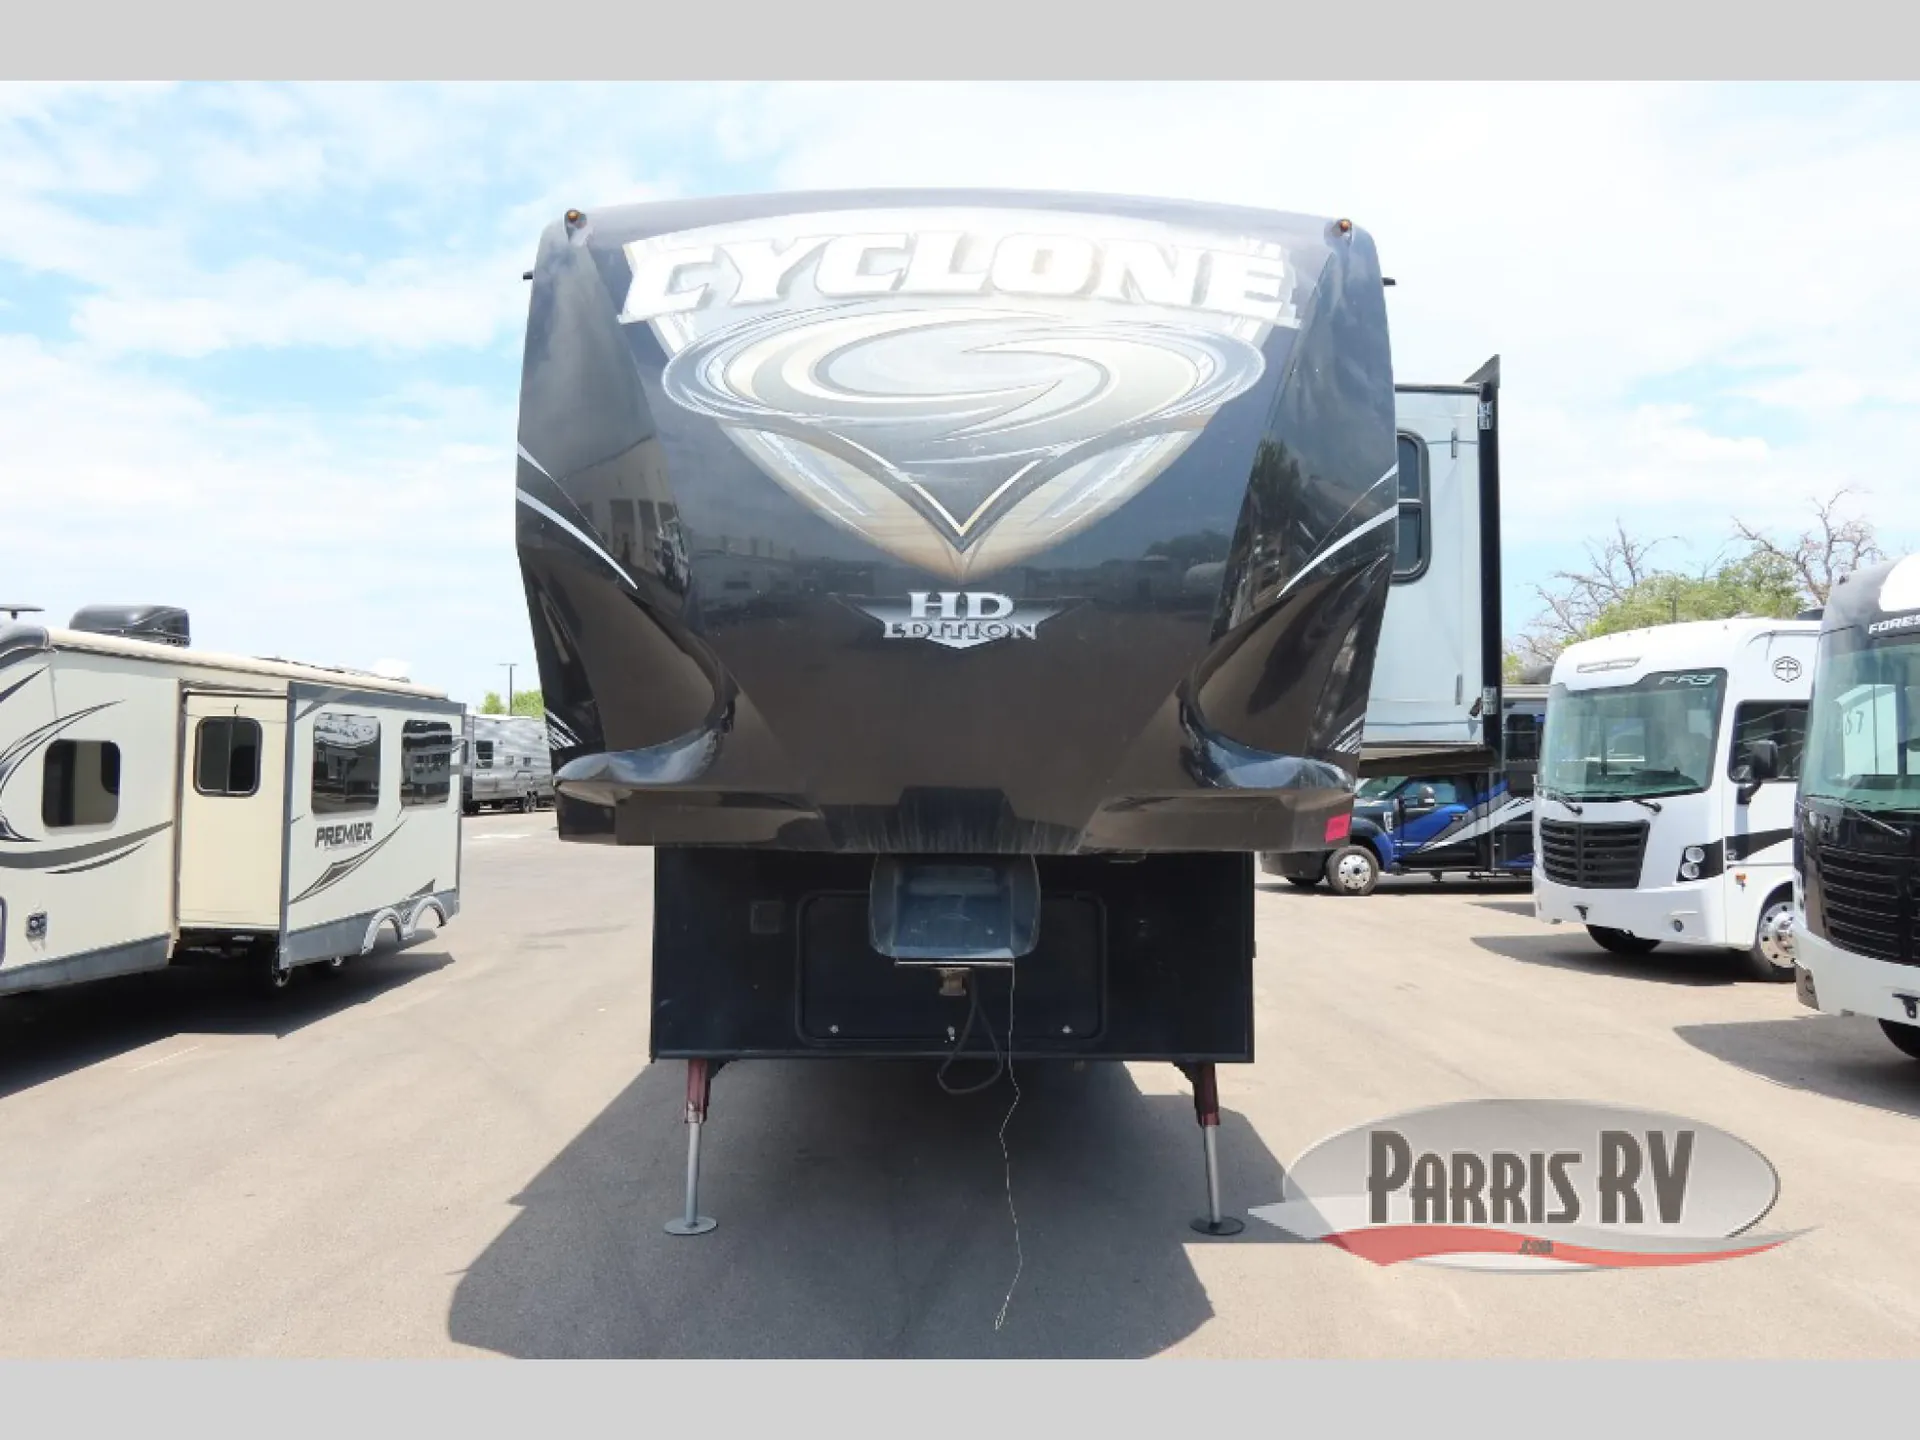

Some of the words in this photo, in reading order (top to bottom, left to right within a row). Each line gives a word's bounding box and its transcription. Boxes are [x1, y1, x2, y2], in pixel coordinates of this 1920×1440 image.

[624, 232, 1290, 322] CYCLONE
[908, 591, 1014, 619] HD
[882, 620, 1038, 641] EDITION
[315, 822, 373, 848] PREMIER
